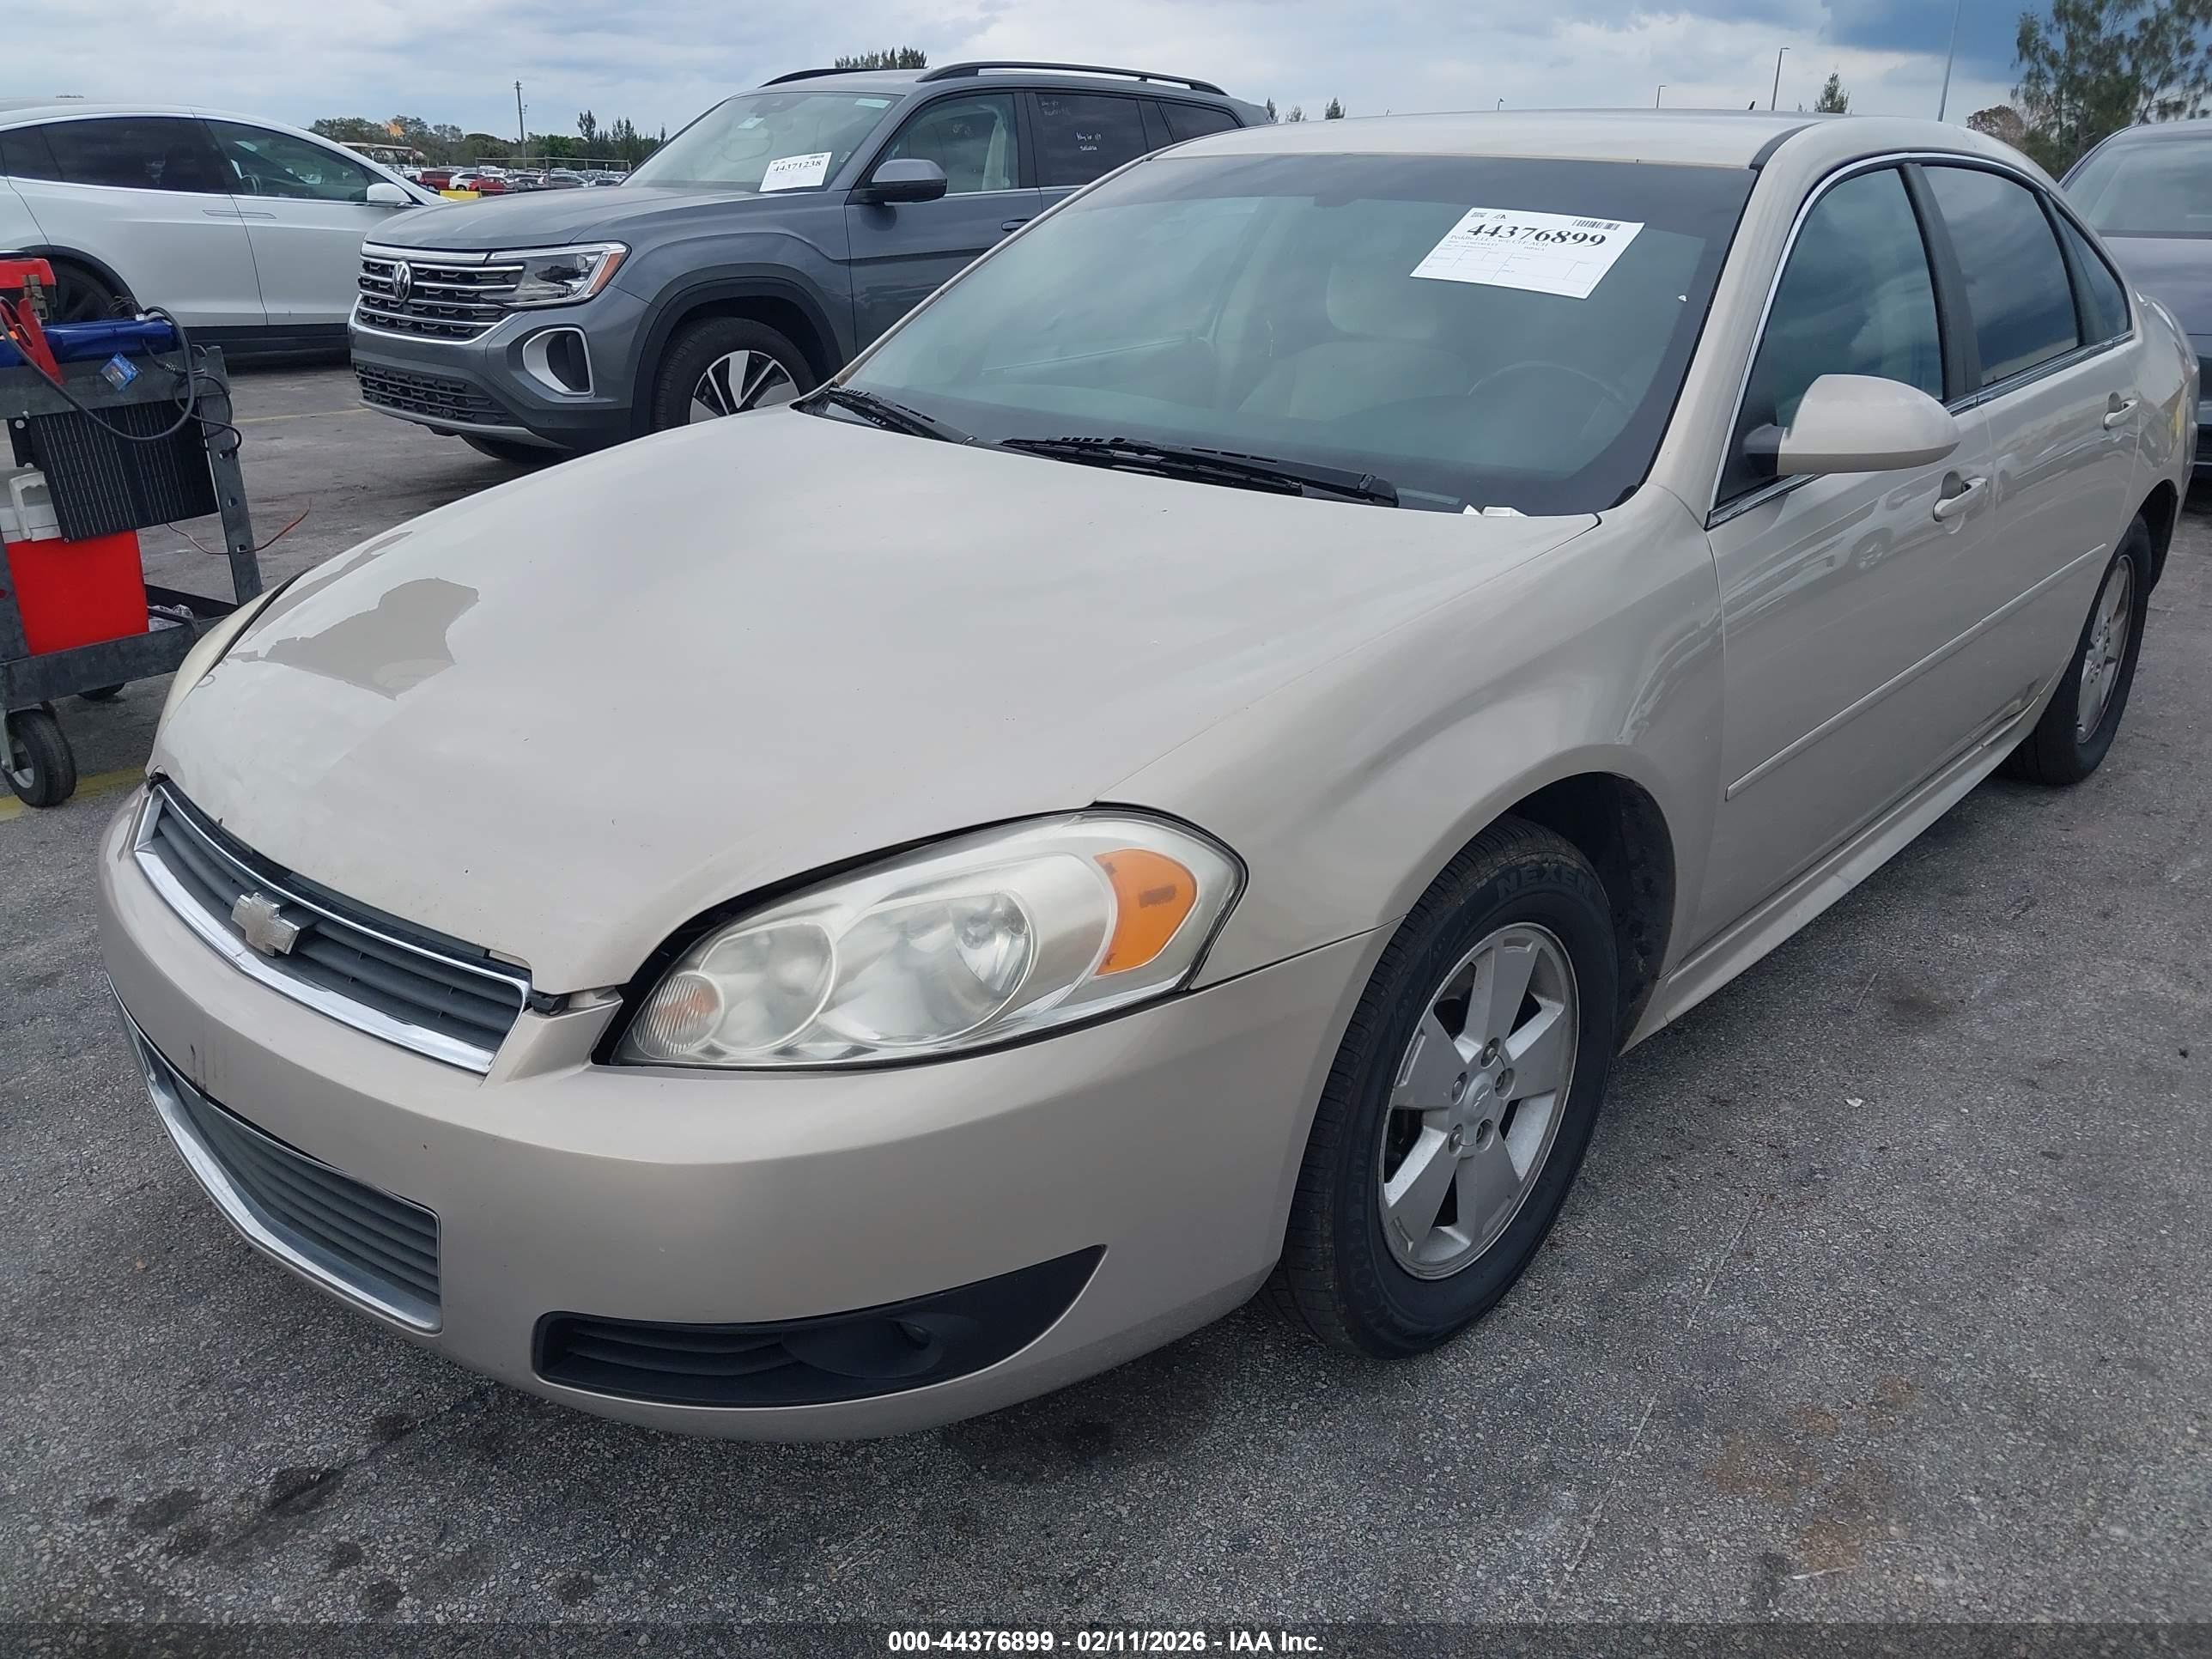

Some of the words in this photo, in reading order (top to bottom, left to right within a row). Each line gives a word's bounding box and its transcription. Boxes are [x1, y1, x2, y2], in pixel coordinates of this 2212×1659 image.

[773, 160, 822, 173] 44371238
[1467, 223, 1607, 247] 44376899
[1497, 865, 1595, 903] NEXEN
